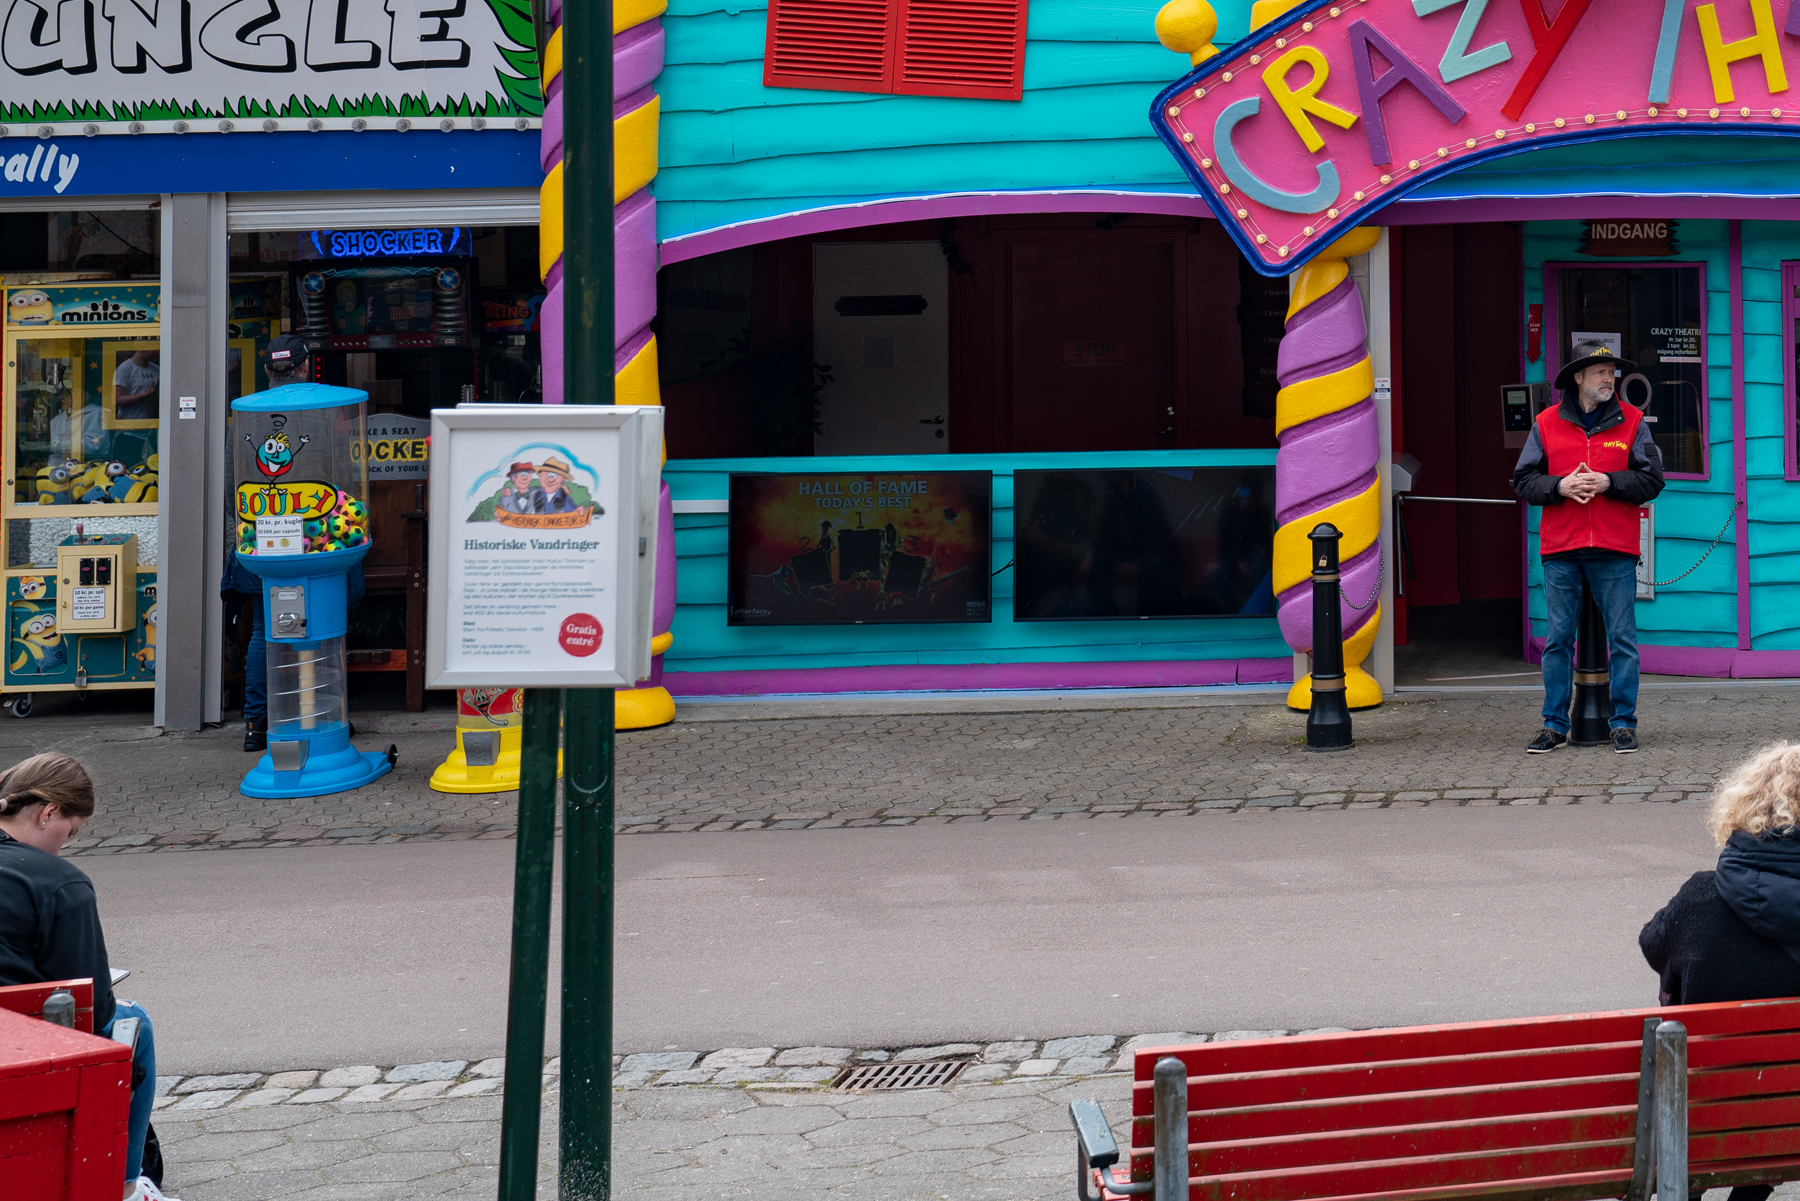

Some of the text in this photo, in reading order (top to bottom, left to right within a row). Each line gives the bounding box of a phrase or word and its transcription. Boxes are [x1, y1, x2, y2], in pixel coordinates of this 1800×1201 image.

[1591, 222, 1668, 239] INDGANG
[330, 229, 444, 257] SHOCKER
[61, 307, 148, 322] minions
[234, 304, 262, 317] minions
[485, 304, 530, 319] BLING
[1650, 327, 1674, 336] CRAZY
[1074, 343, 1116, 357] STOP
[391, 427, 417, 435] SEAT
[385, 465, 395, 473] OF
[398, 465, 419, 473] YOUR
[798, 480, 928, 496] HALL OF FAME
[238, 488, 333, 516] BOULY
[814, 496, 912, 509] TODAY'S BEST
[464, 539, 600, 552] Historiske Vandringer
[734, 608, 769, 616] alterface
[566, 623, 597, 636] Gratis
[566, 634, 595, 647] entré
